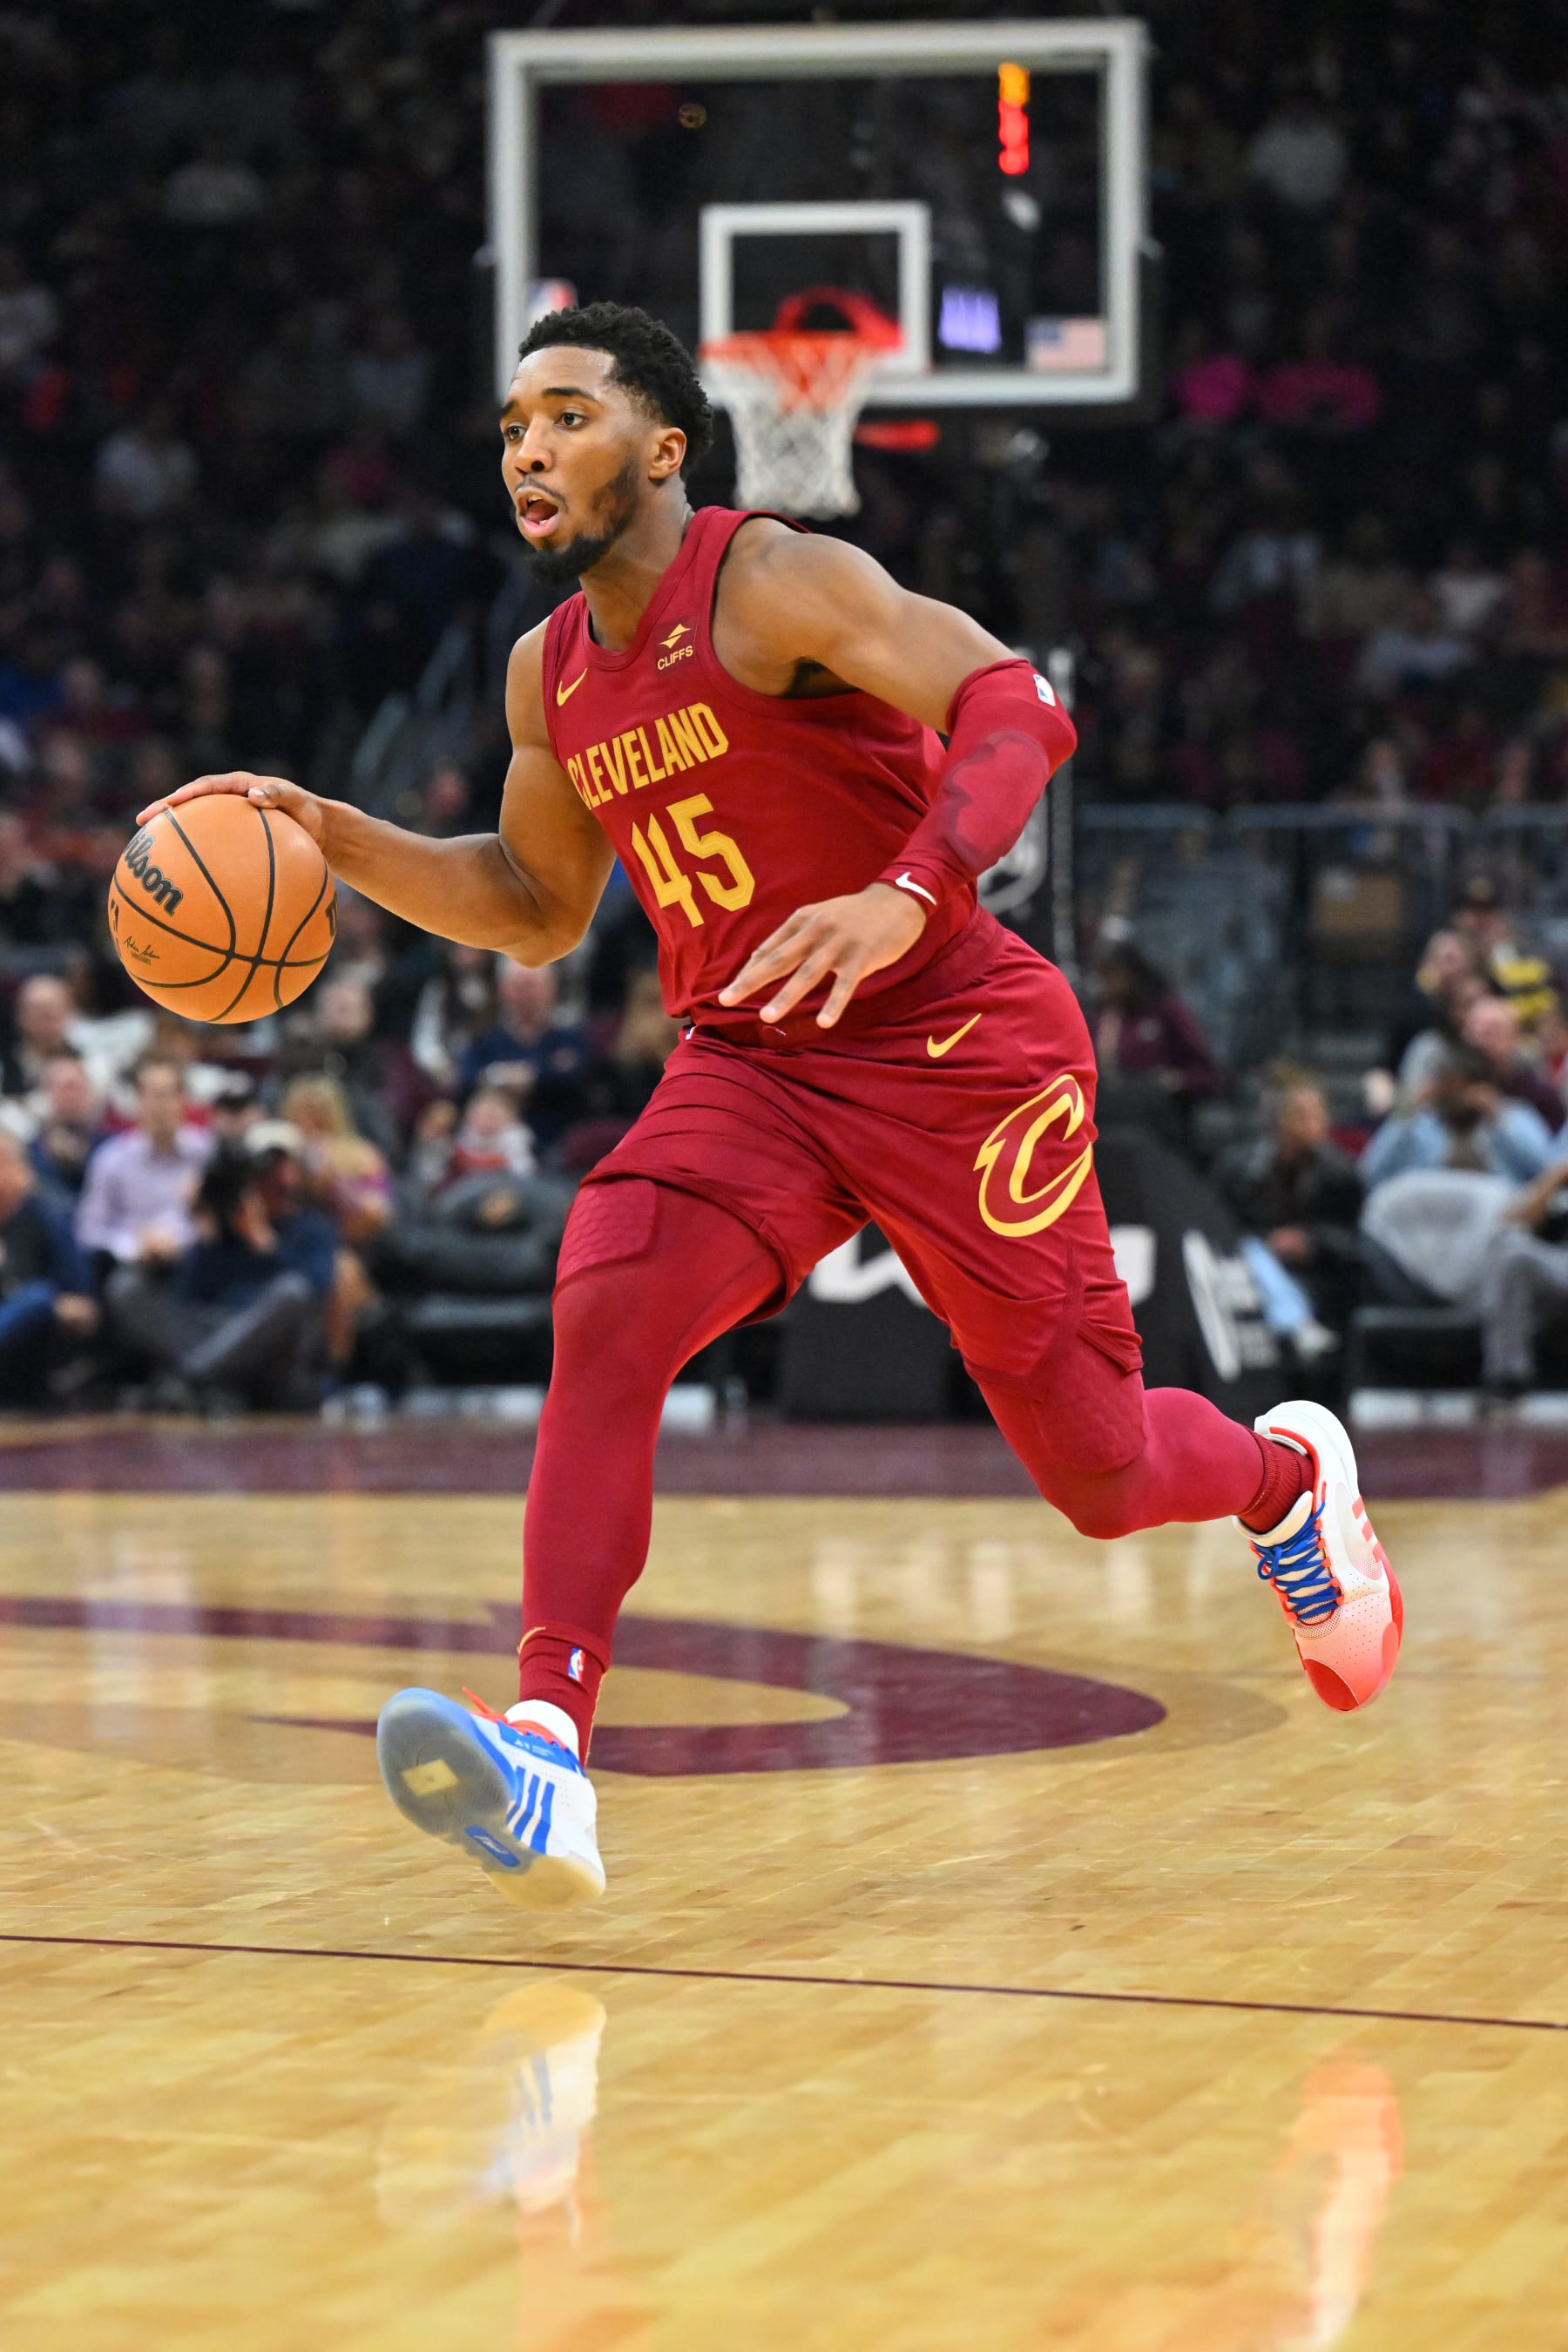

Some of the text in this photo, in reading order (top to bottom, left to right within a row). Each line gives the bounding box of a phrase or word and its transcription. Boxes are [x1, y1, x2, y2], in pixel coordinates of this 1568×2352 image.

[657, 645, 693, 671] CLIFFS
[567, 702, 729, 811] CLEVELAND
[124, 826, 183, 917] ilson
[632, 793, 755, 928] 45
